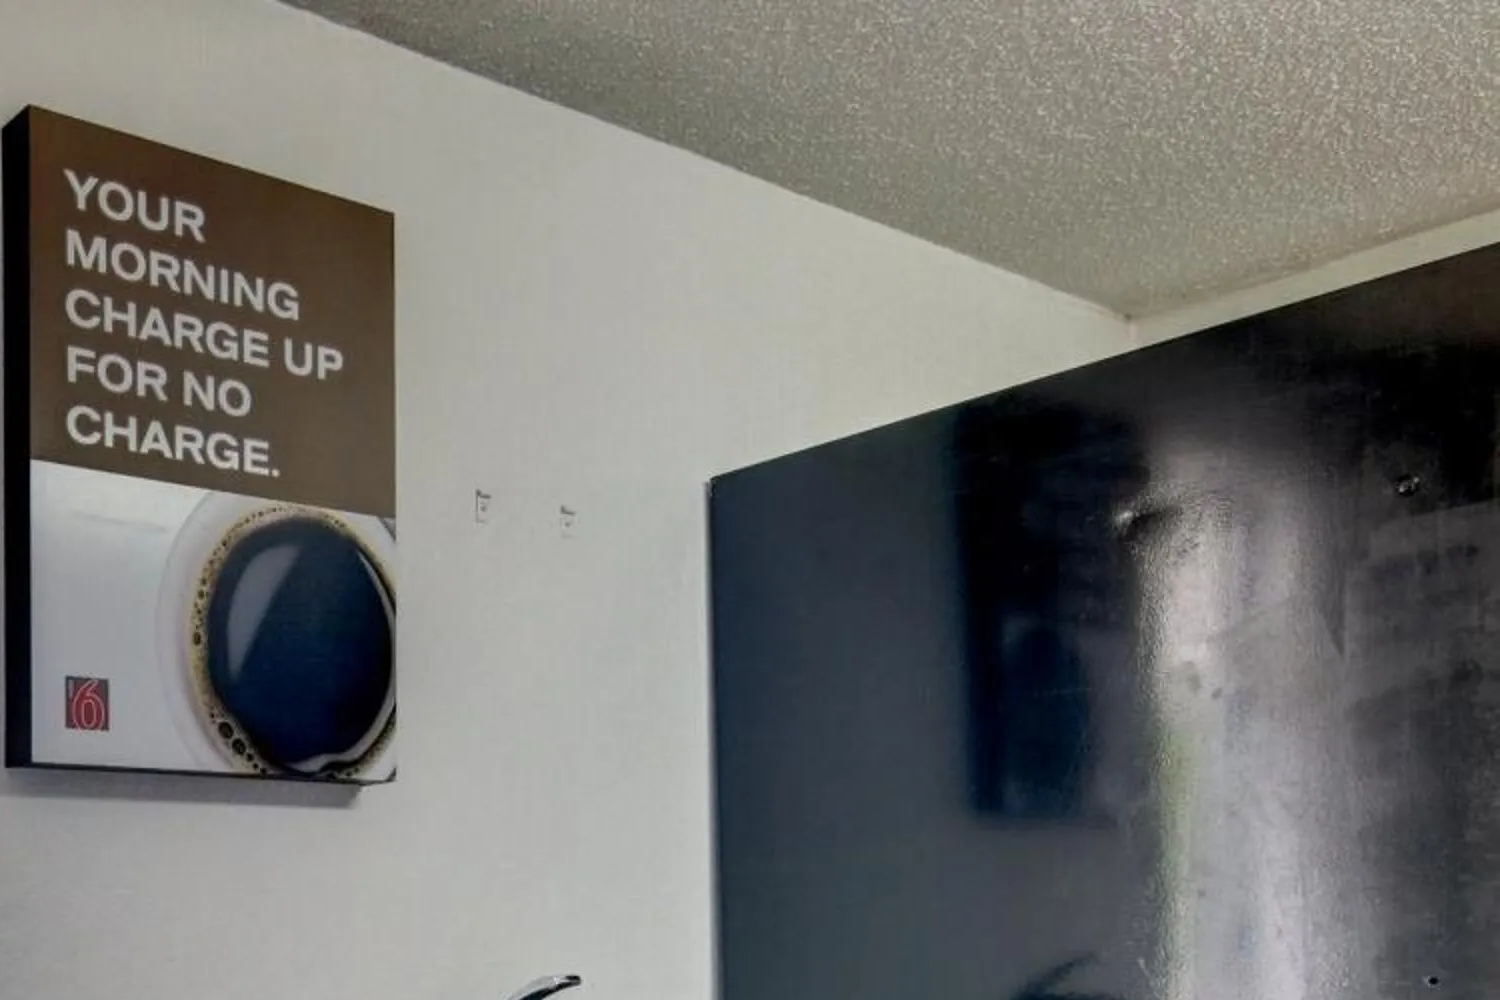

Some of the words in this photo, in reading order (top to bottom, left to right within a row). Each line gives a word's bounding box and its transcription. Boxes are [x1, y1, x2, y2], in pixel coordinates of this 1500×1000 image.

[64, 169, 206, 243] YOUR
[66, 229, 299, 320] MORNING
[65, 290, 269, 367] CHARGE
[284, 338, 343, 380] UP
[66, 346, 168, 401] FOR
[183, 371, 252, 417] NO
[66, 406, 280, 477] CHARGE.
[72, 679, 105, 731] 6
